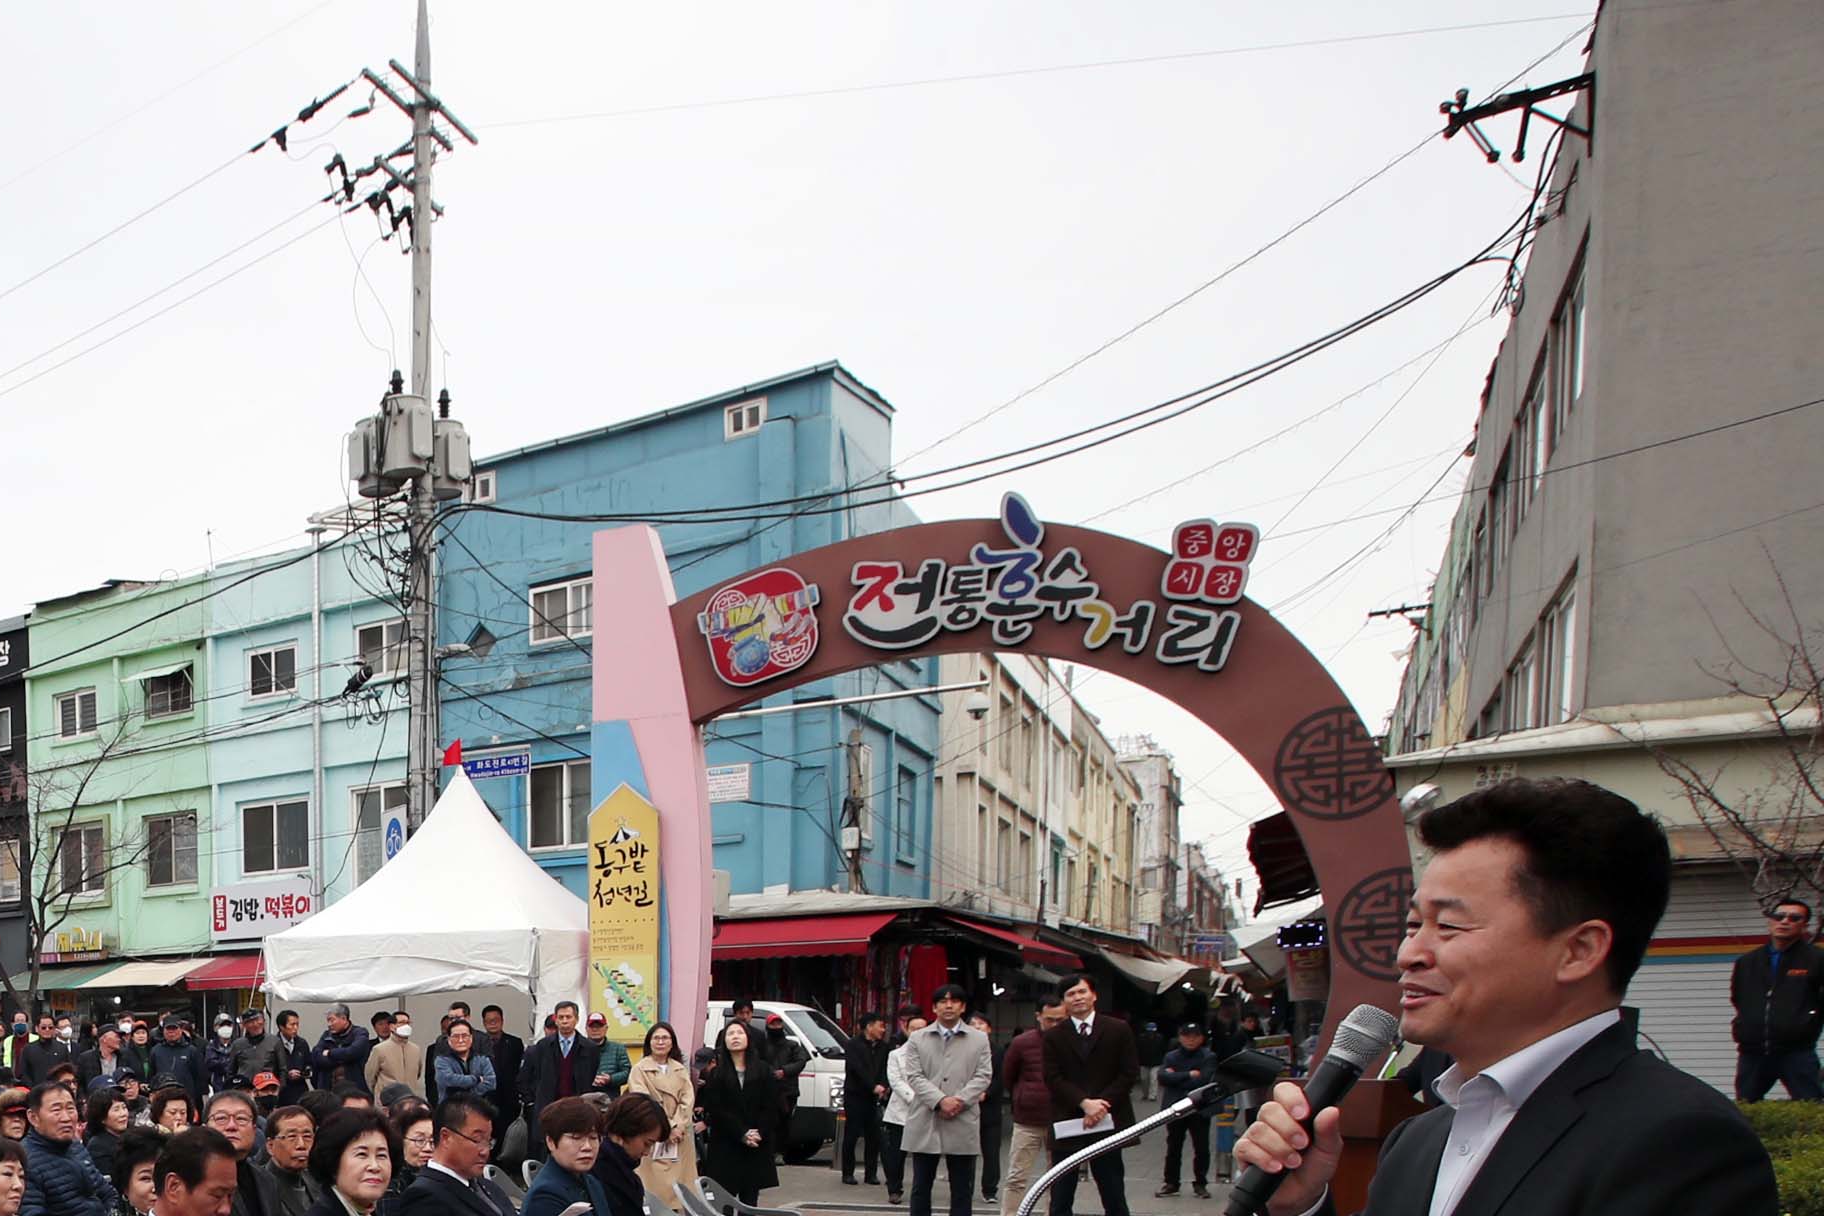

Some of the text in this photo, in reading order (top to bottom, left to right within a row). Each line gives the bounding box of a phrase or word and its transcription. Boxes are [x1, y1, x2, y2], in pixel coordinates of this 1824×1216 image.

[1182, 528, 1247, 560] 중앙
[1172, 570, 1239, 596] 시장
[594, 840, 650, 877] 동구밭
[265, 893, 310, 919] 떡볶이
[592, 878, 654, 908] 청년길
